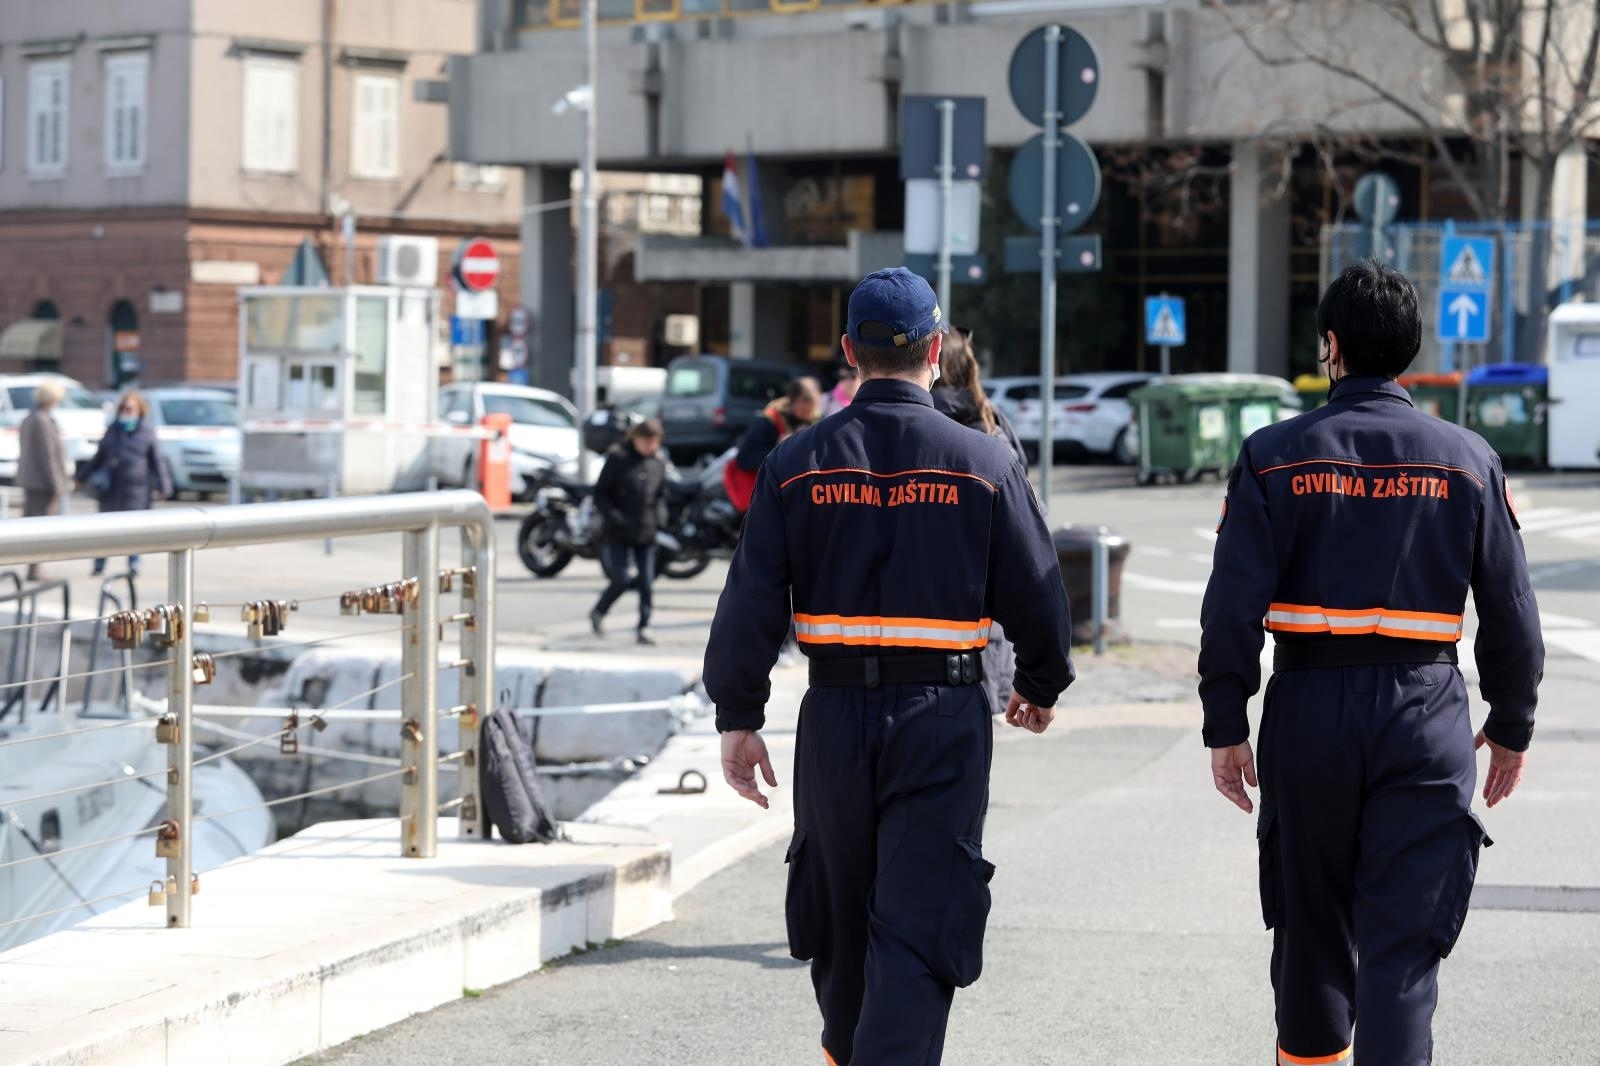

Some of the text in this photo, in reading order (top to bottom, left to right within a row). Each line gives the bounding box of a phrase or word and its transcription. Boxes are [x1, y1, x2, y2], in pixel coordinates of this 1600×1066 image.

[811, 478, 959, 507] CIVILNA ZAŠTITA
[1291, 472, 1449, 499] CIVILNA ZAŠTITA
